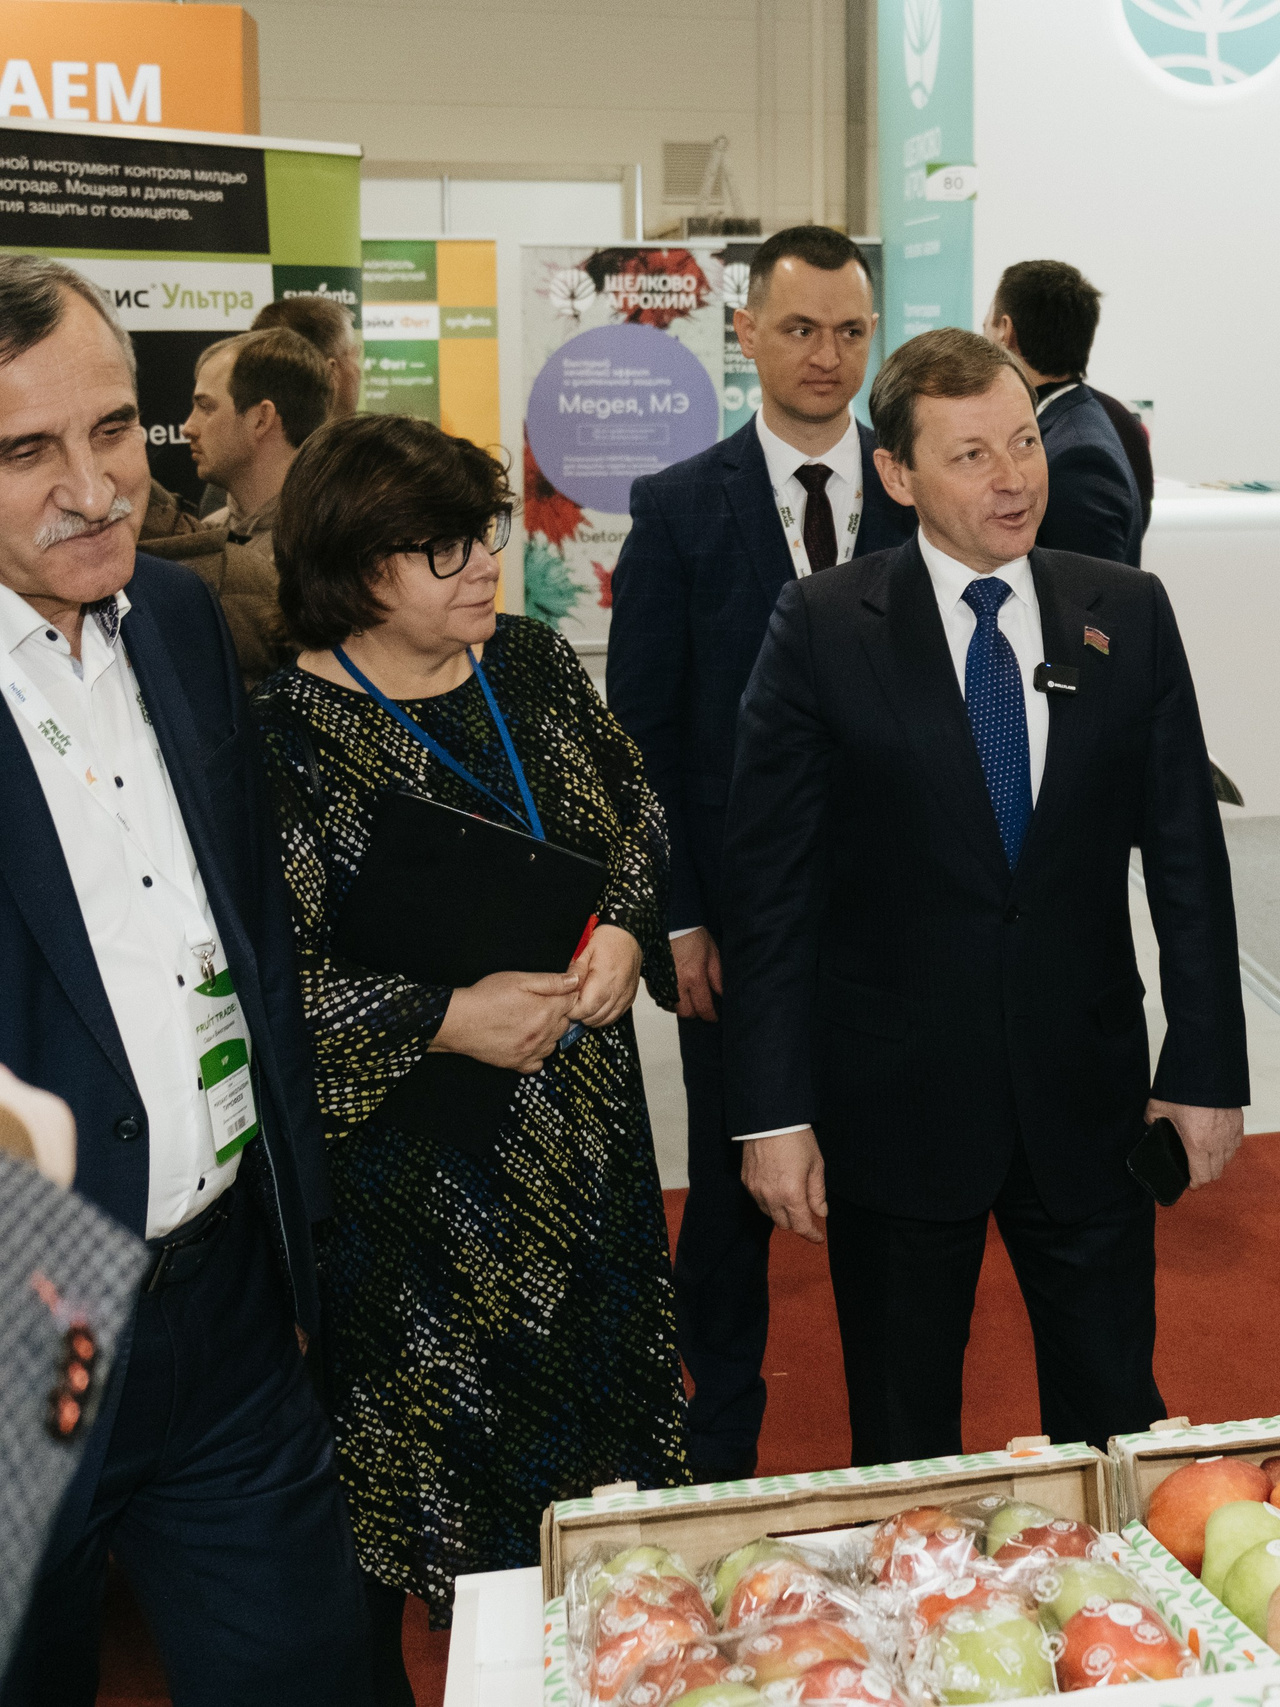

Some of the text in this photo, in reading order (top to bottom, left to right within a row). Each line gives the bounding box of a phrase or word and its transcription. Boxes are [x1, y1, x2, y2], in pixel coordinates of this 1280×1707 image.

[32, 160, 121, 177] инструмент
[124, 164, 191, 181] контроля
[194, 169, 248, 185] милдью
[943, 176, 964, 190] 80
[66, 179, 128, 199] Мощная
[130, 186, 141, 198] и
[143, 185, 224, 203] длительная
[29, 201, 88, 217] защиты
[91, 205, 107, 217] от
[110, 206, 193, 221] оомицетов.
[604, 274, 697, 292] ЩЕЛКОВО
[161, 282, 254, 317] Ультра
[604, 292, 697, 310] АГРОХИМ
[558, 392, 690, 419] Медея, МЭ
